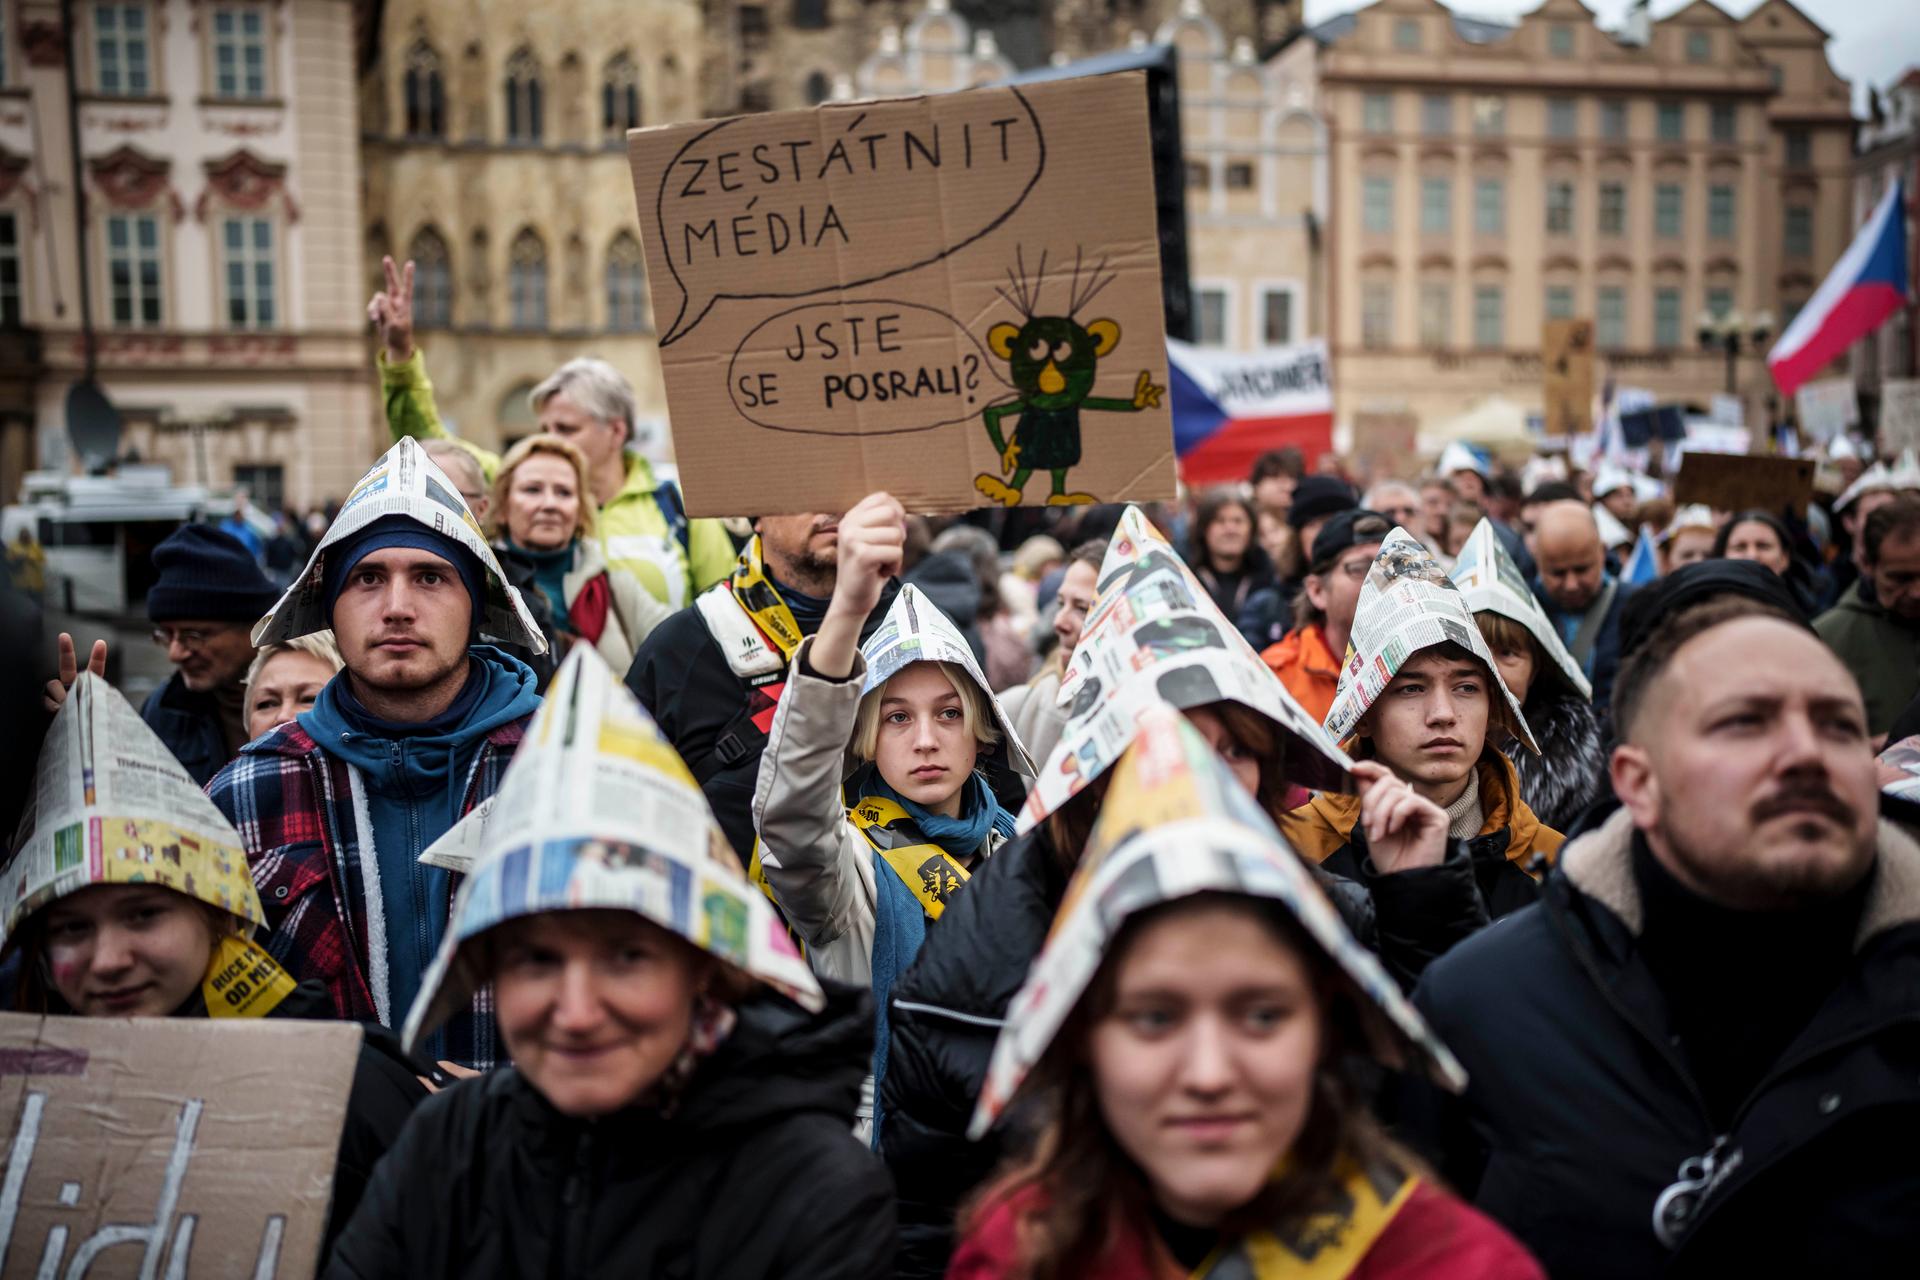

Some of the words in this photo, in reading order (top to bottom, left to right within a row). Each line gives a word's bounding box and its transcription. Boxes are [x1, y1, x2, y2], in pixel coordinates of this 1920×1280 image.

[679, 112, 1019, 198] ZESTÁTNIT
[684, 195, 850, 265] MÉDIA
[785, 314, 902, 361] JSTE
[738, 372, 779, 407] SE
[824, 354, 980, 408] POSRALI?
[751, 673, 779, 686] USWE
[211, 957, 248, 993] RUCE
[225, 980, 251, 1008] OD
